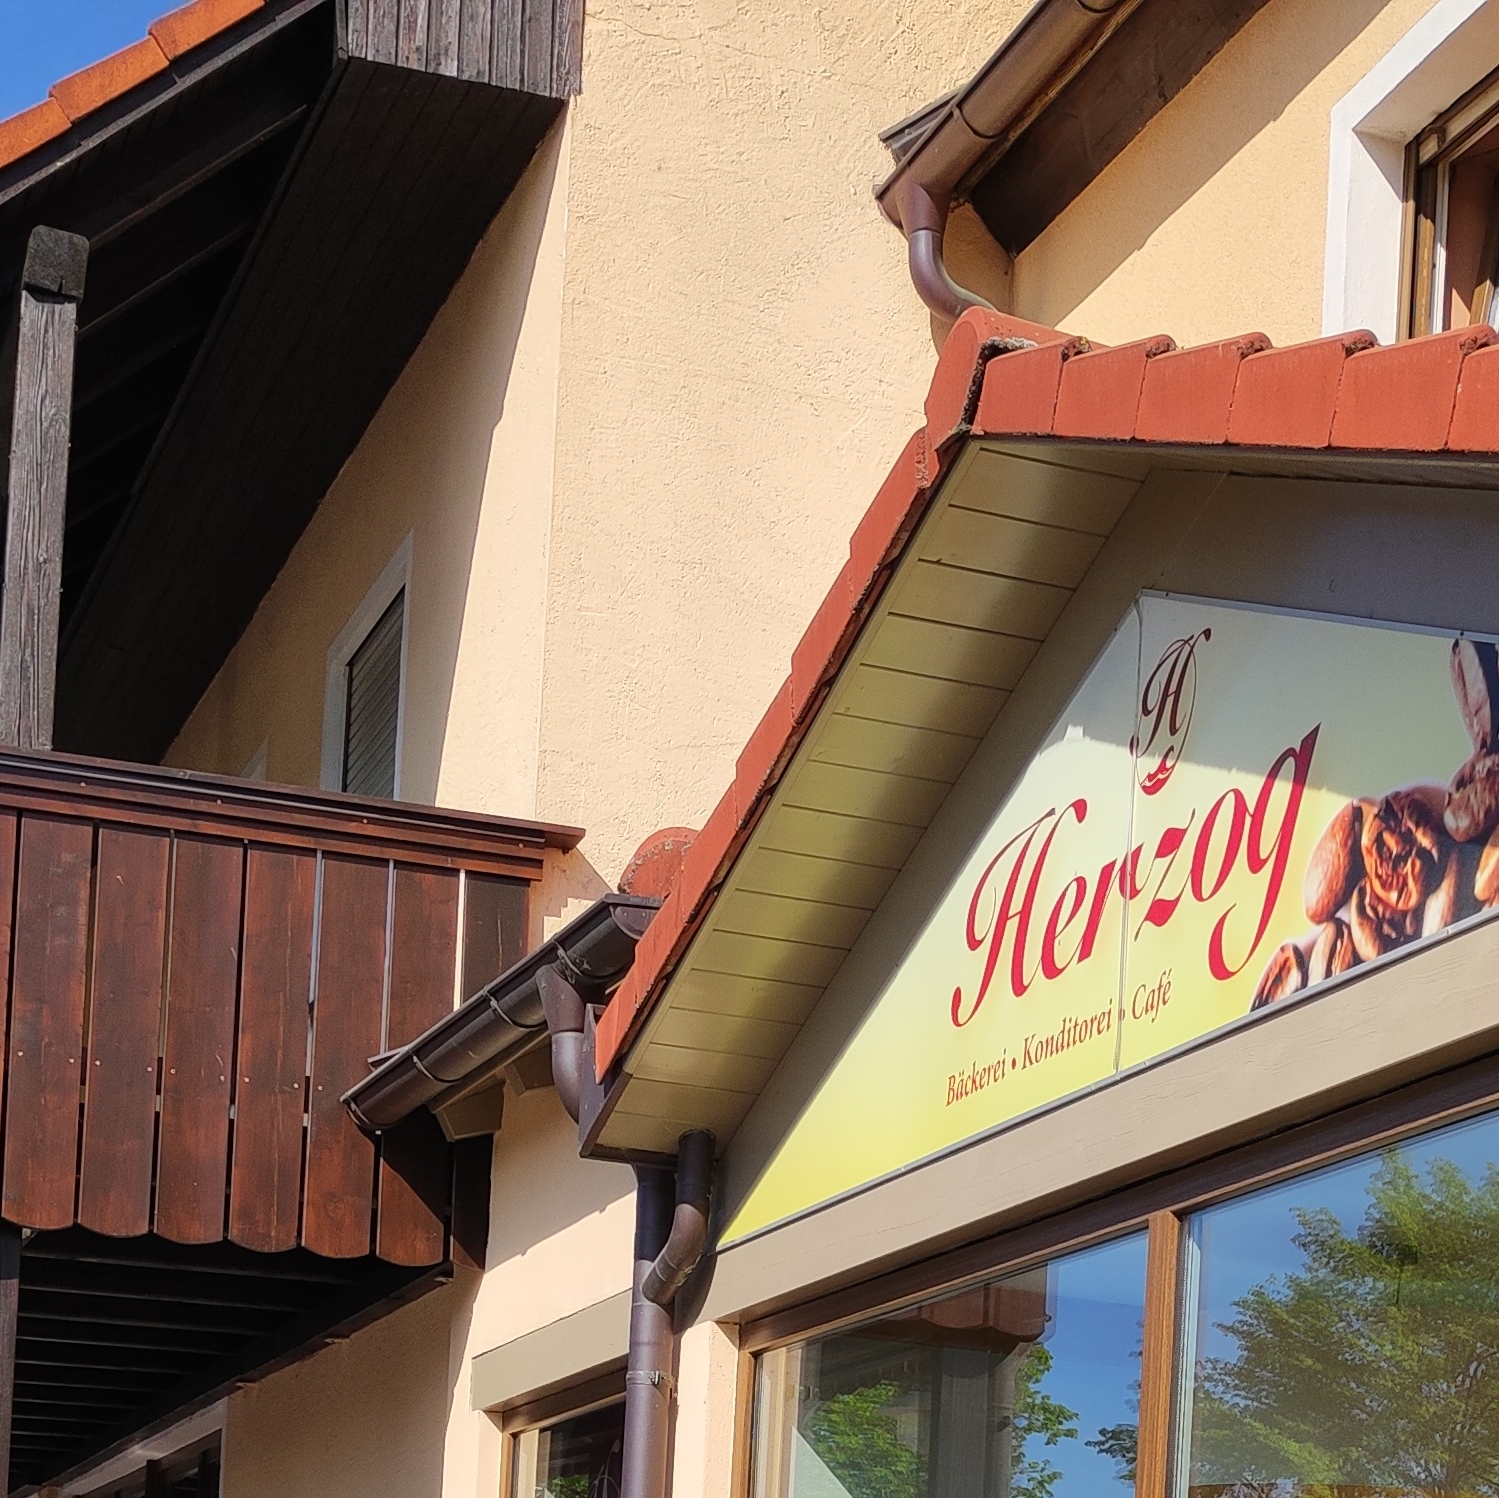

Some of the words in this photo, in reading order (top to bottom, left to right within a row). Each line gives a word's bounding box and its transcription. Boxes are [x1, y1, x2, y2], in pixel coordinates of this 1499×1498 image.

[951, 722, 1321, 1027] Herzog
[945, 1048, 1007, 1107] Bäckerei
[1021, 998, 1113, 1070] Konditorei
[1131, 968, 1173, 1023] Café
